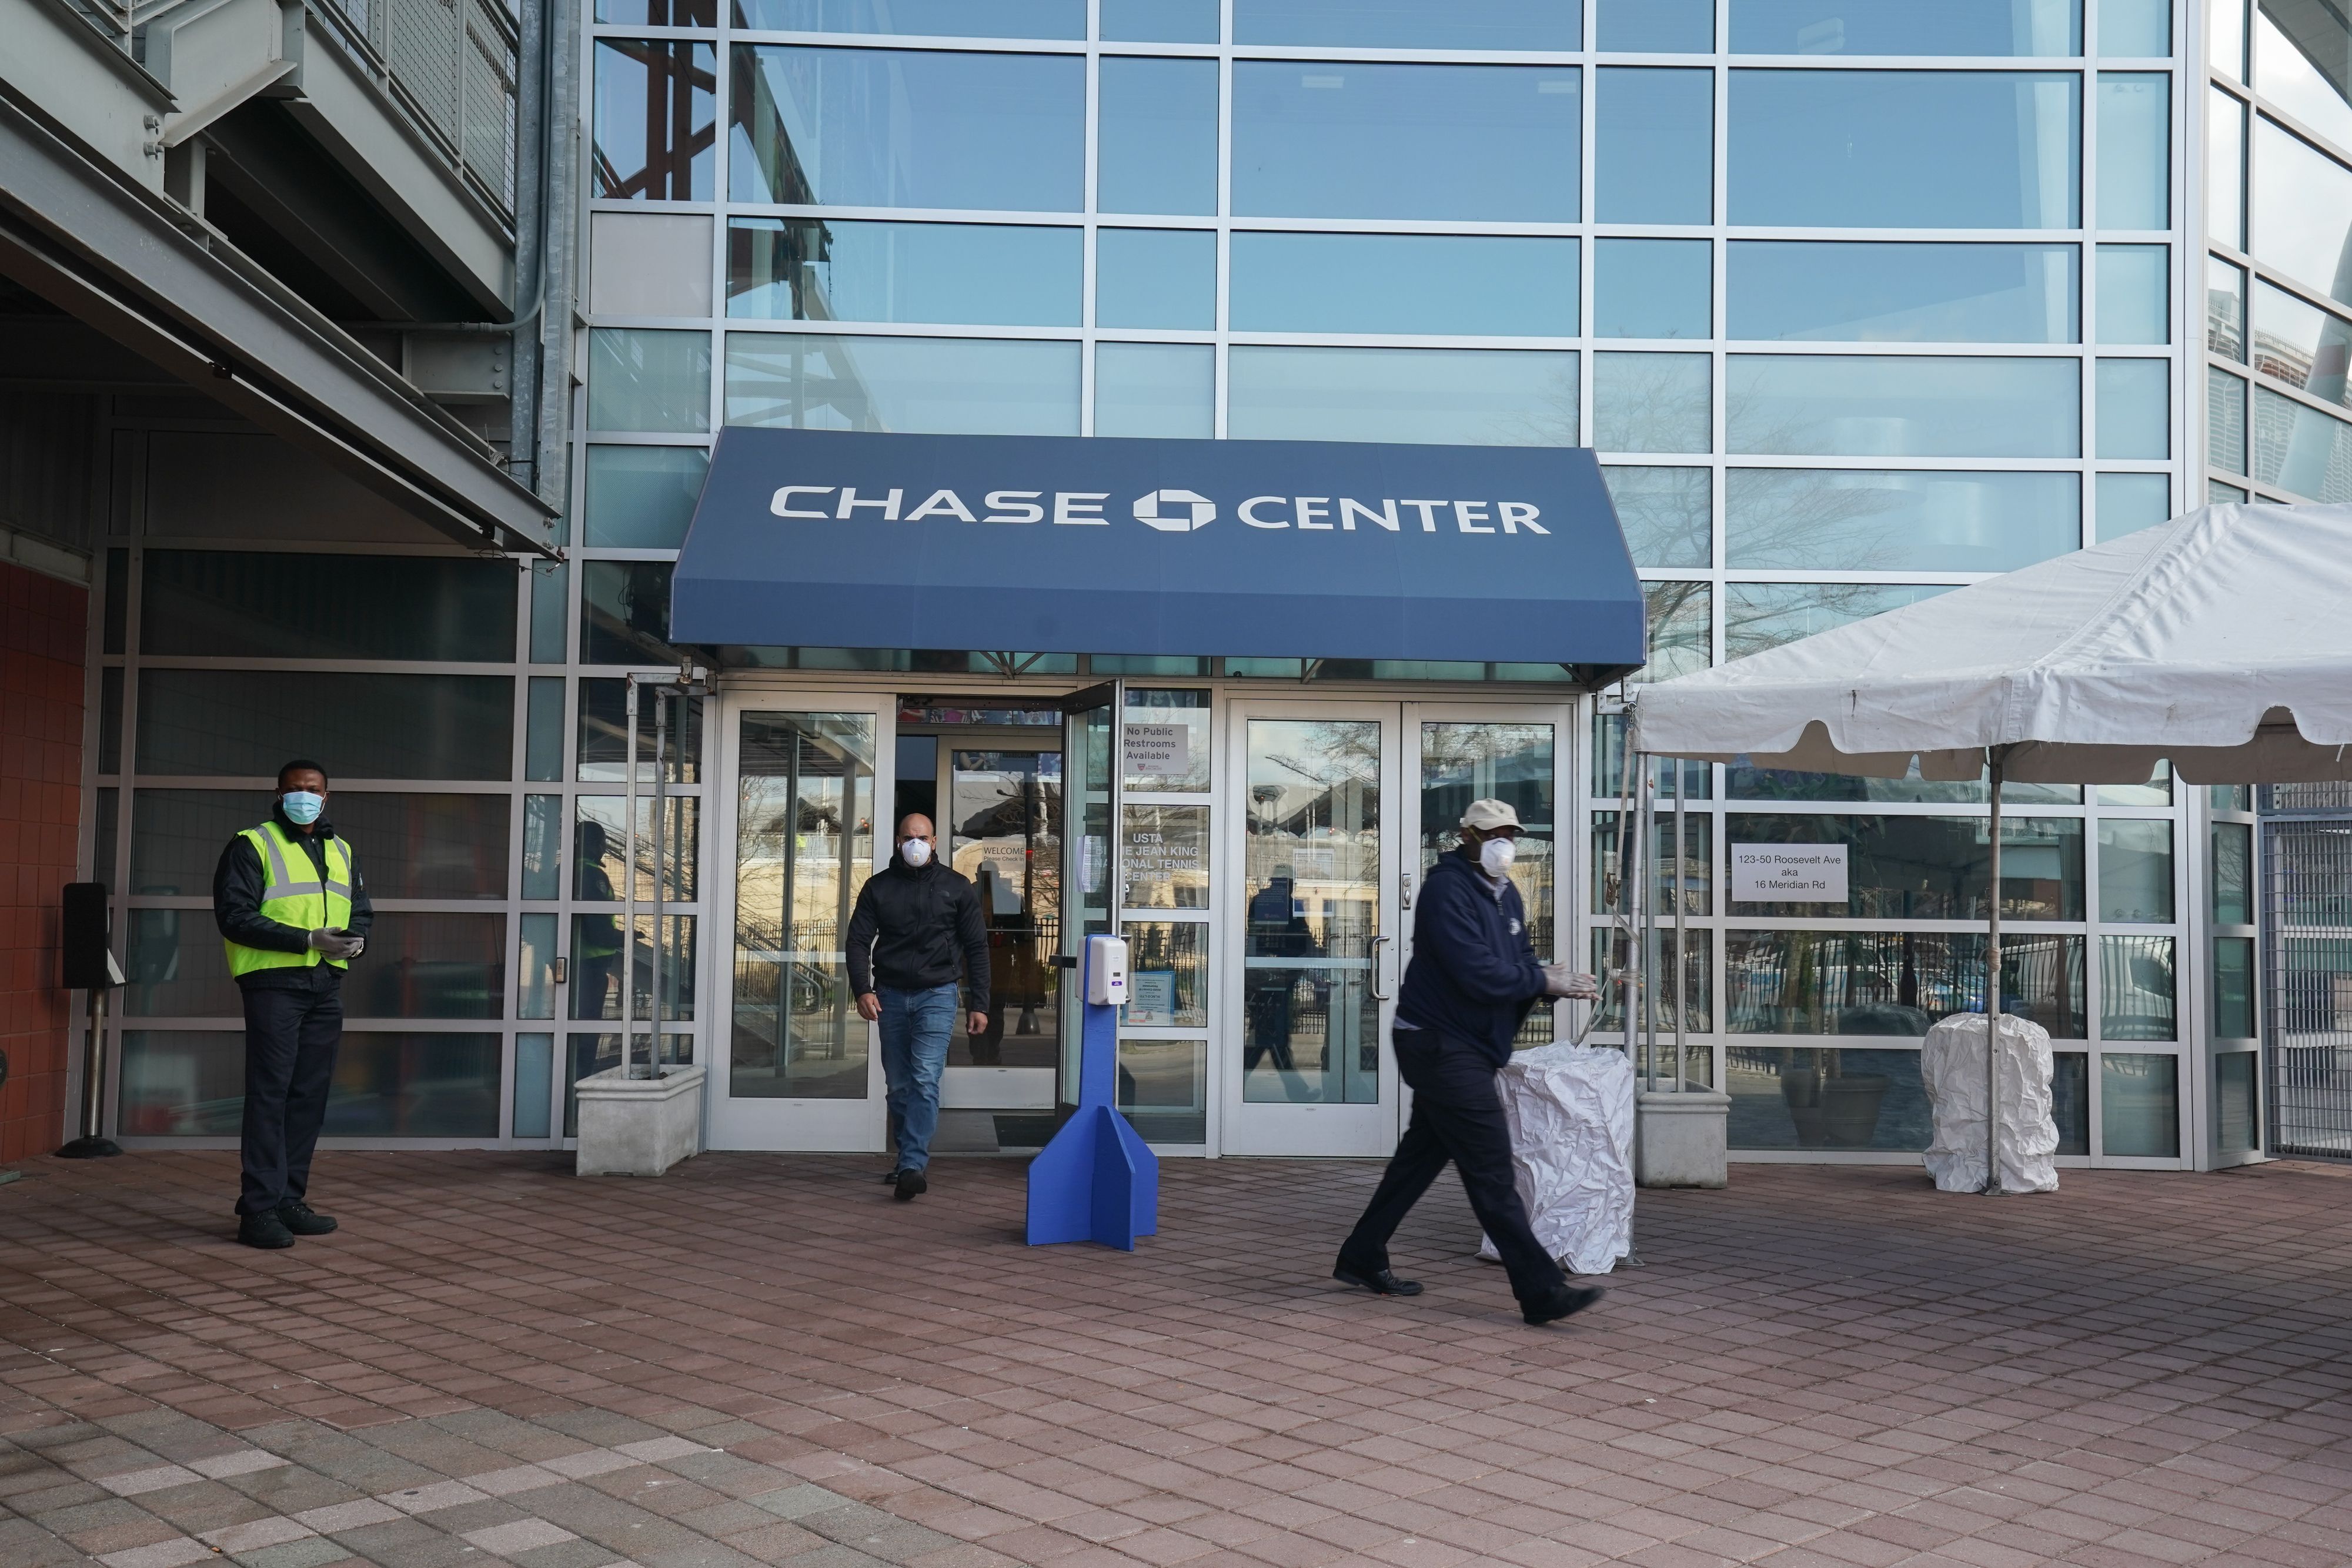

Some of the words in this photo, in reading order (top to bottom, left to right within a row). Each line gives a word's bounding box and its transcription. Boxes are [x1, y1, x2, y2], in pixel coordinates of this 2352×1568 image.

[770, 486, 1111, 525] CHASE
[1237, 496, 1552, 534] CENTER
[1144, 727, 1173, 735] Public
[1124, 739, 1176, 747] Restrooms
[1126, 751, 1170, 760] Available
[1133, 833, 1163, 843] USTA
[1135, 847, 1167, 856] JEAN
[1170, 847, 1199, 856] KING
[1157, 859, 1200, 869] TENNIS
[1739, 855, 1772, 864] 123-50
[1775, 855, 1820, 864] Roosevelt
[1823, 856, 1841, 864] Ave
[1125, 872, 1170, 881] CENTER
[1781, 868, 1798, 876] aka
[1755, 881, 1766, 889] 16
[1769, 881, 1809, 889] Meridian
[1812, 881, 1825, 889] Rd
